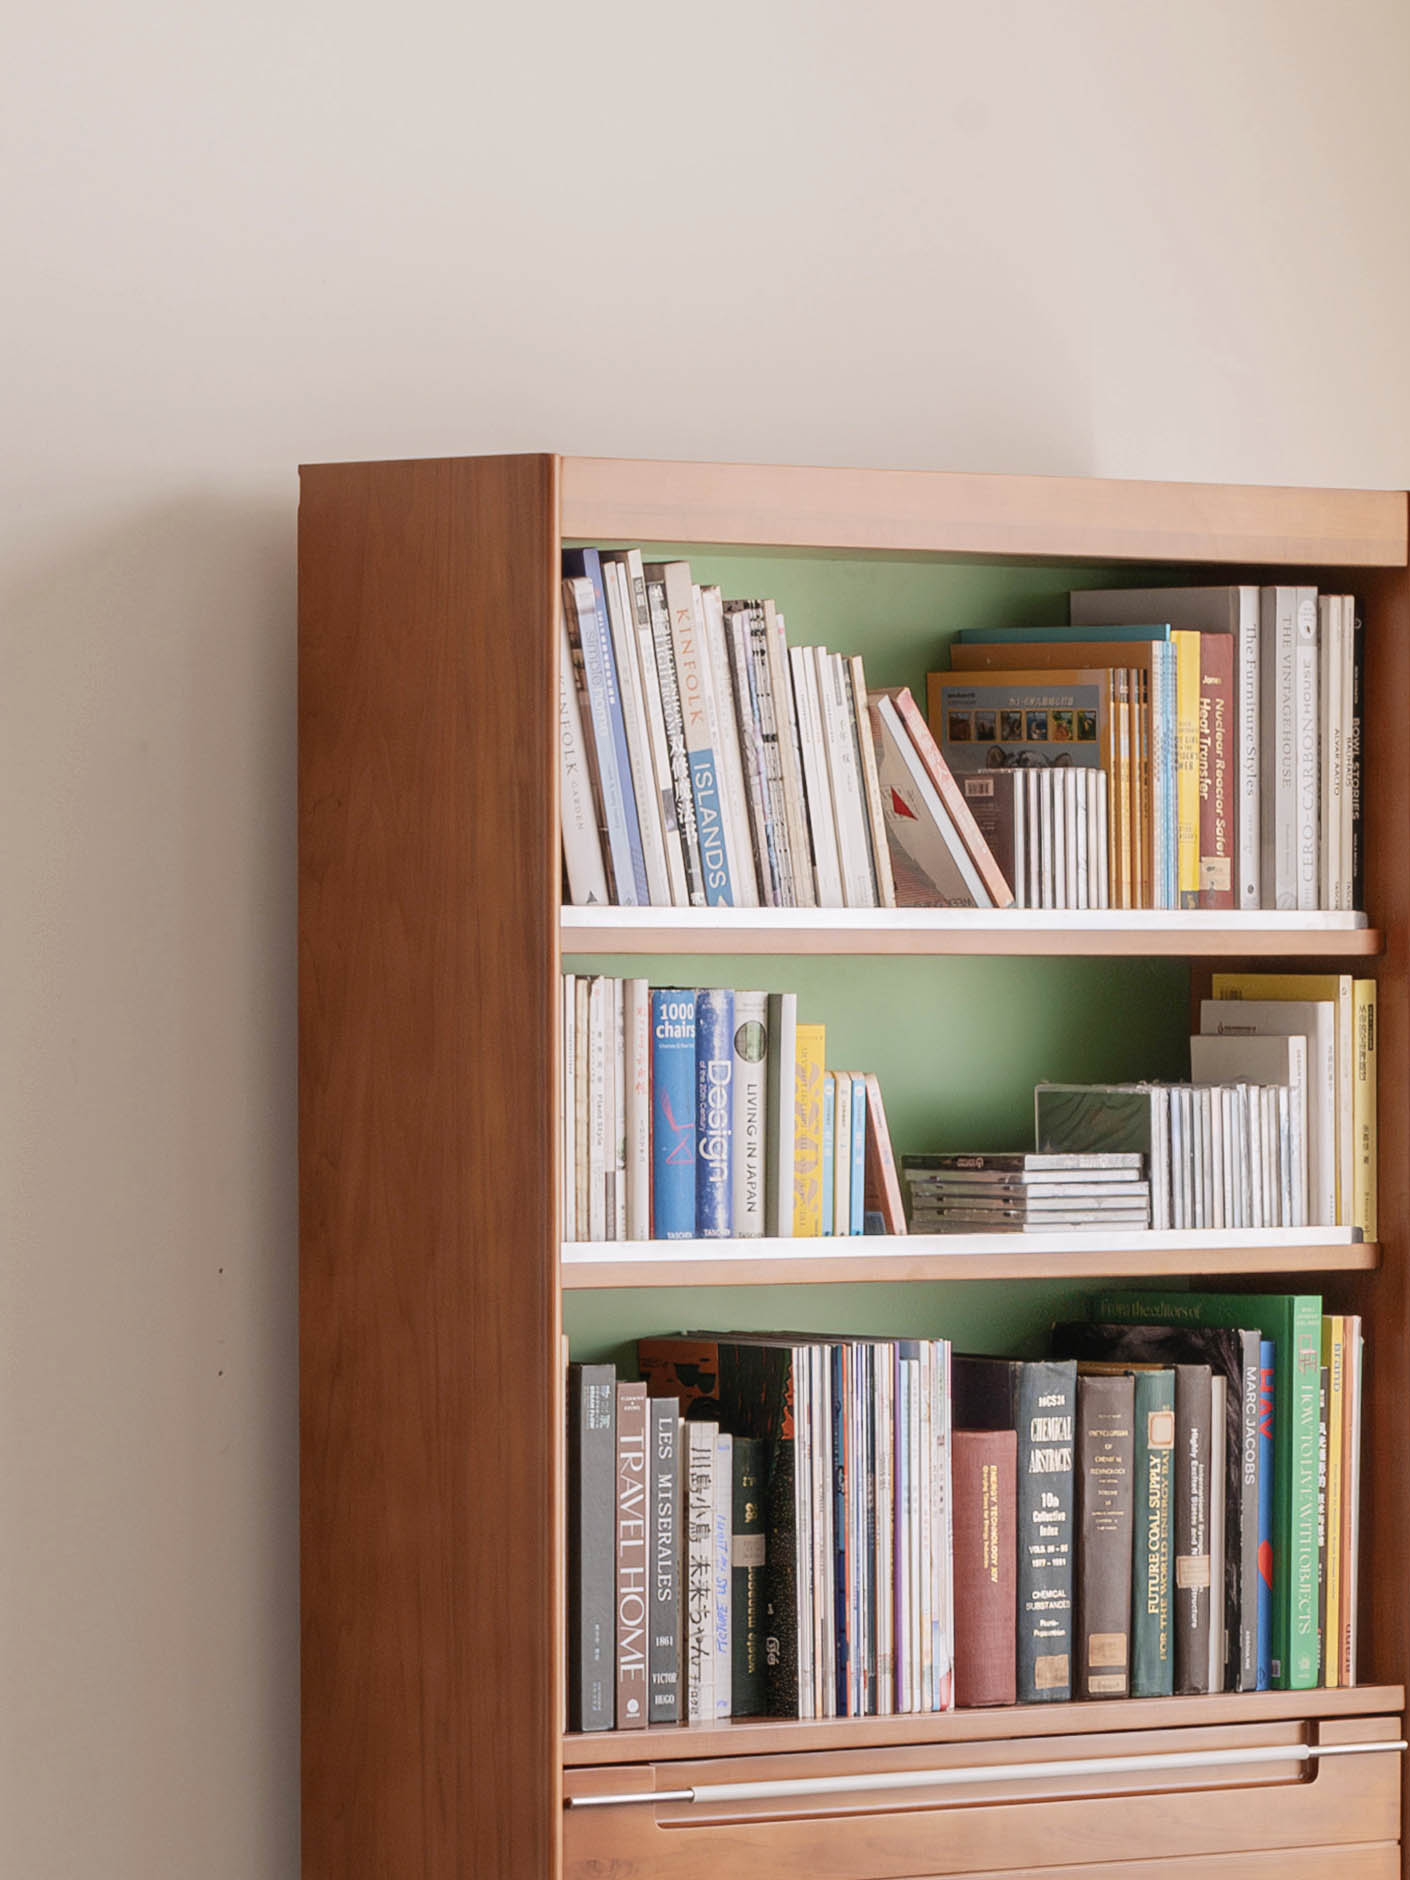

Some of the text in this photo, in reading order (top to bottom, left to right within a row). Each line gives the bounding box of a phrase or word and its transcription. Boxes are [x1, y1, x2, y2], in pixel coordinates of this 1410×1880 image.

[1281, 615, 1292, 648] THE
[676, 607, 703, 727] KINFOLK
[1243, 623, 1257, 797] The Furniture Styles
[1199, 698, 1211, 800] Heat Transfer
[1215, 698, 1226, 857] Nuclear Reactor Safet
[1351, 717, 1360, 821] BOWL STORIES
[693, 761, 727, 890] ISLANDS
[656, 1021, 696, 1038] chairs
[660, 1003, 694, 1020] 1000
[699, 1060, 707, 1069] of
[699, 1069, 707, 1083] the
[697, 1103, 707, 1132] Century
[698, 1060, 732, 1182] Design
[746, 1083, 758, 1214] LIVING IN JAPAN
[1031, 1415, 1072, 1442] CHEMICAL
[1244, 1365, 1258, 1485] MARC JACOBS
[1259, 1367, 1274, 1441] HAY
[1028, 1446, 1072, 1474] ABSTRACTS
[1189, 1428, 1198, 1458] Highly
[619, 1427, 645, 1558] TRAVEL
[989, 1465, 998, 1504] ENERGY
[1190, 1460, 1198, 1495] Excited
[657, 1417, 673, 1602] LES MISERALES
[989, 1505, 998, 1565] TECHNOLOGY
[1147, 1455, 1160, 1615] FUTURE COAL SUPPLY
[1159, 1476, 1168, 1537] ENERGY
[1298, 1385, 1314, 1634] HOW TO LIVE WITH OBJECTS
[1190, 1527, 1198, 1545] and
[1159, 1540, 1168, 1595] WORLD
[619, 1567, 645, 1682] HOME
[1159, 1598, 1168, 1629] THE
[1159, 1631, 1168, 1661] FOR
[652, 1673, 677, 1684] VICTOR
[655, 1694, 675, 1705] HUGO
